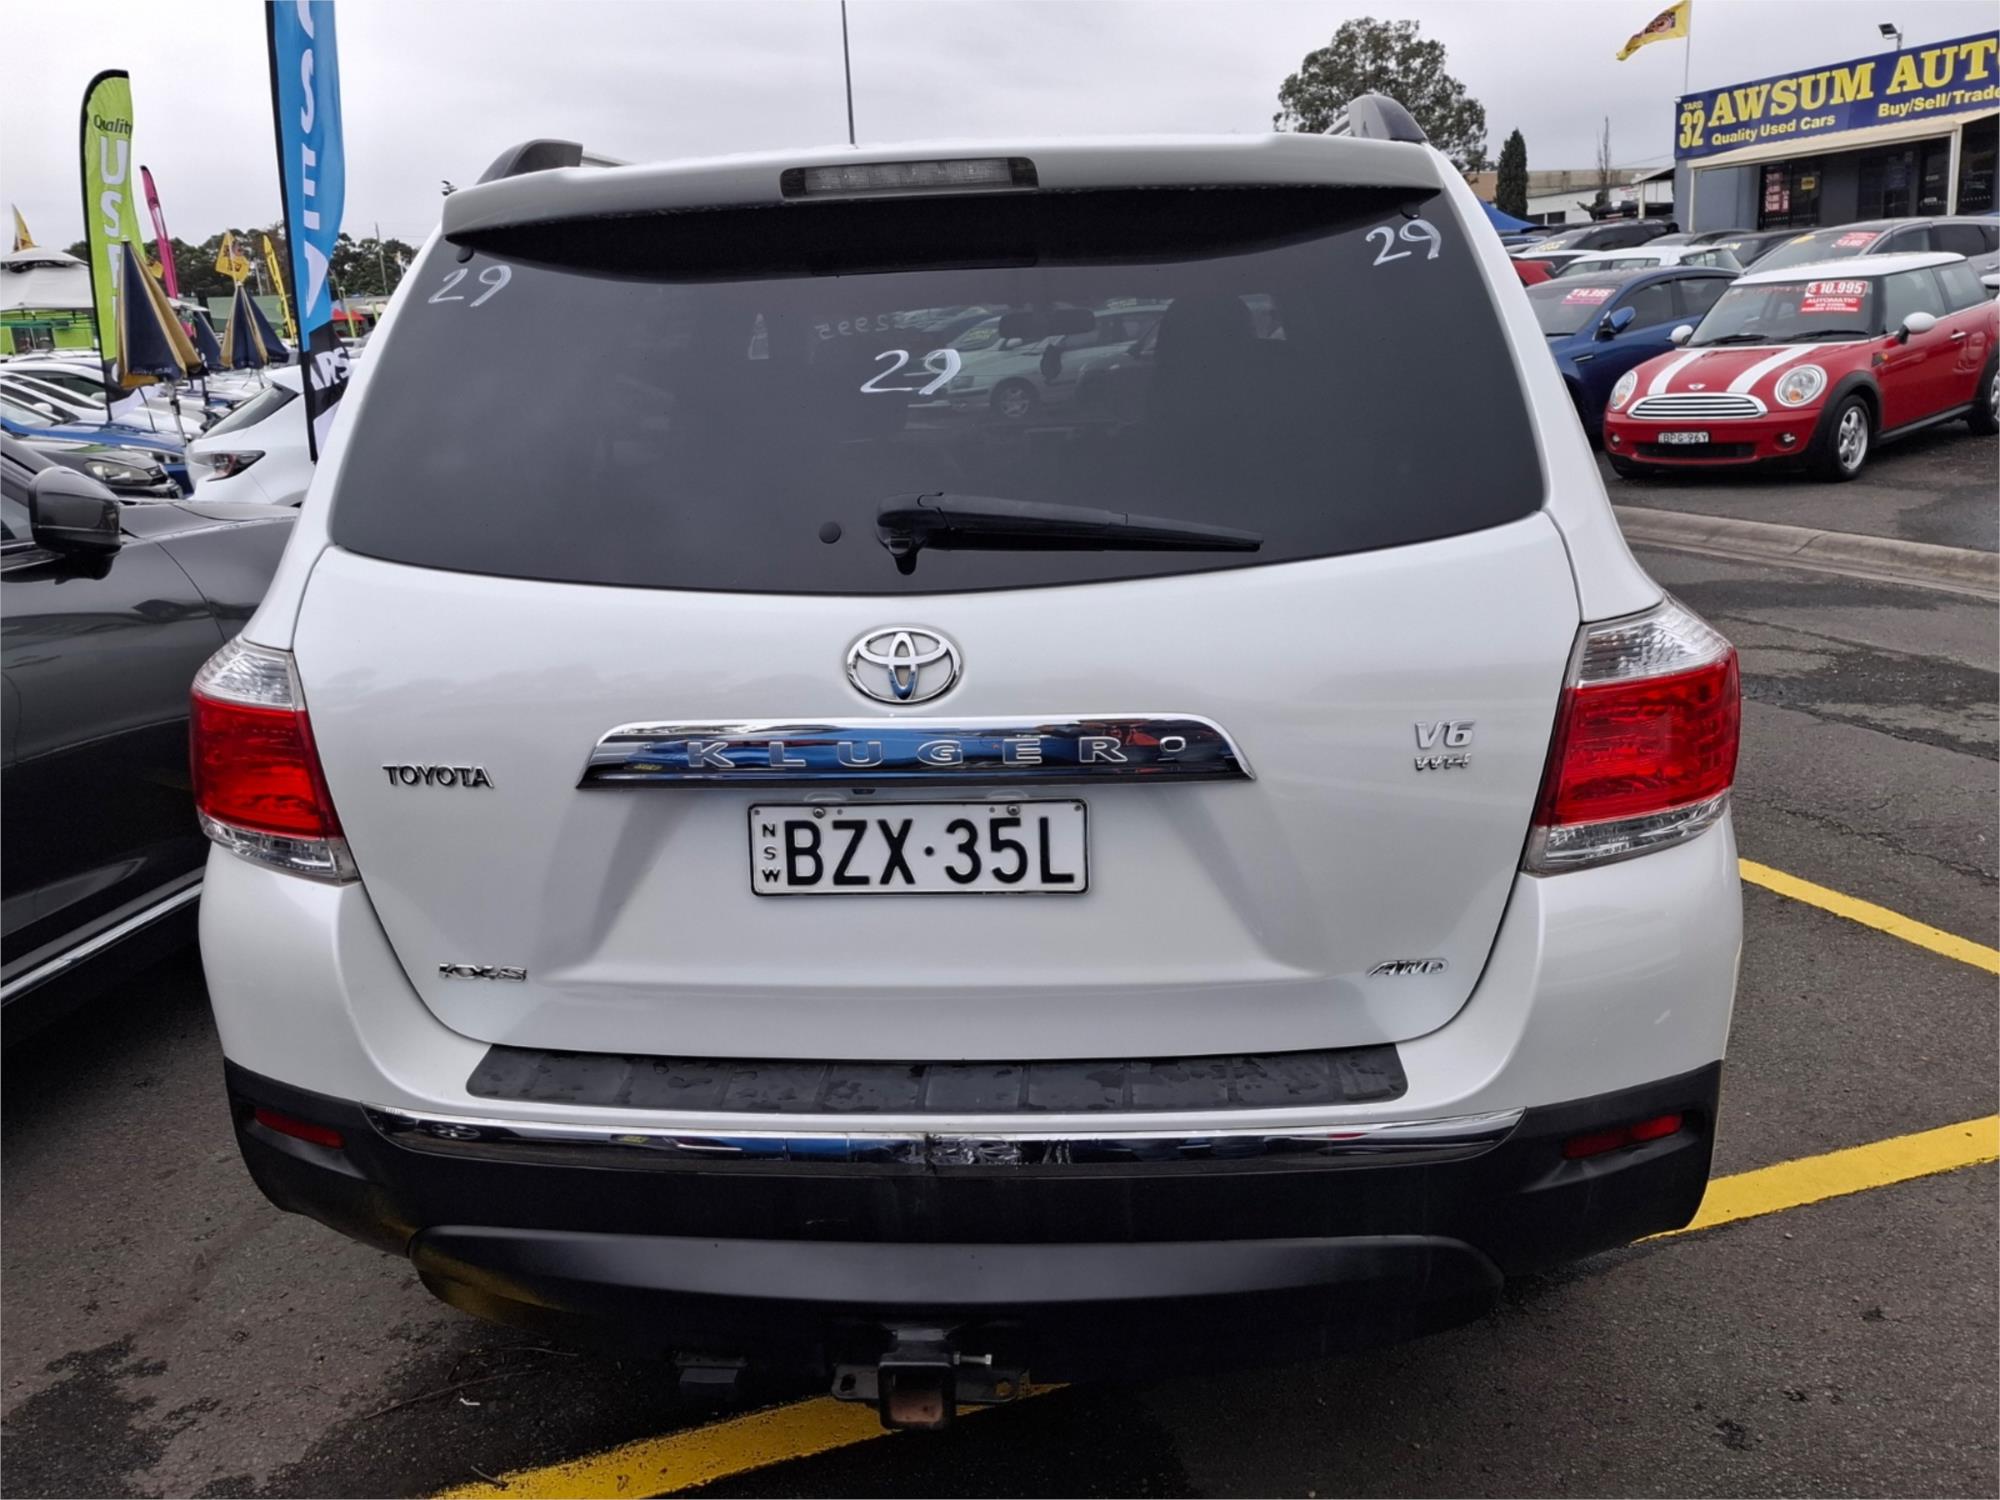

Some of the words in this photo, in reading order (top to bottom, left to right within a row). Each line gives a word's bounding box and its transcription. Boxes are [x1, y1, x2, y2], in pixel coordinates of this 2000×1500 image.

[1708, 62, 1876, 127] AWSUM
[1886, 38, 2000, 95] AUT
[1683, 101, 1704, 111] YARD
[1680, 110, 1705, 149] 32
[1712, 128, 1758, 146] Quality
[1760, 119, 1796, 137] Used
[1801, 115, 1835, 131] Cars
[1365, 219, 1442, 267] 29
[427, 264, 512, 308] 29
[860, 348, 962, 395] 29
[1414, 720, 1475, 750] V6
[687, 736, 1128, 769] KLUGER
[382, 764, 494, 788] TOYOTA
[1367, 958, 1449, 977] AWD
